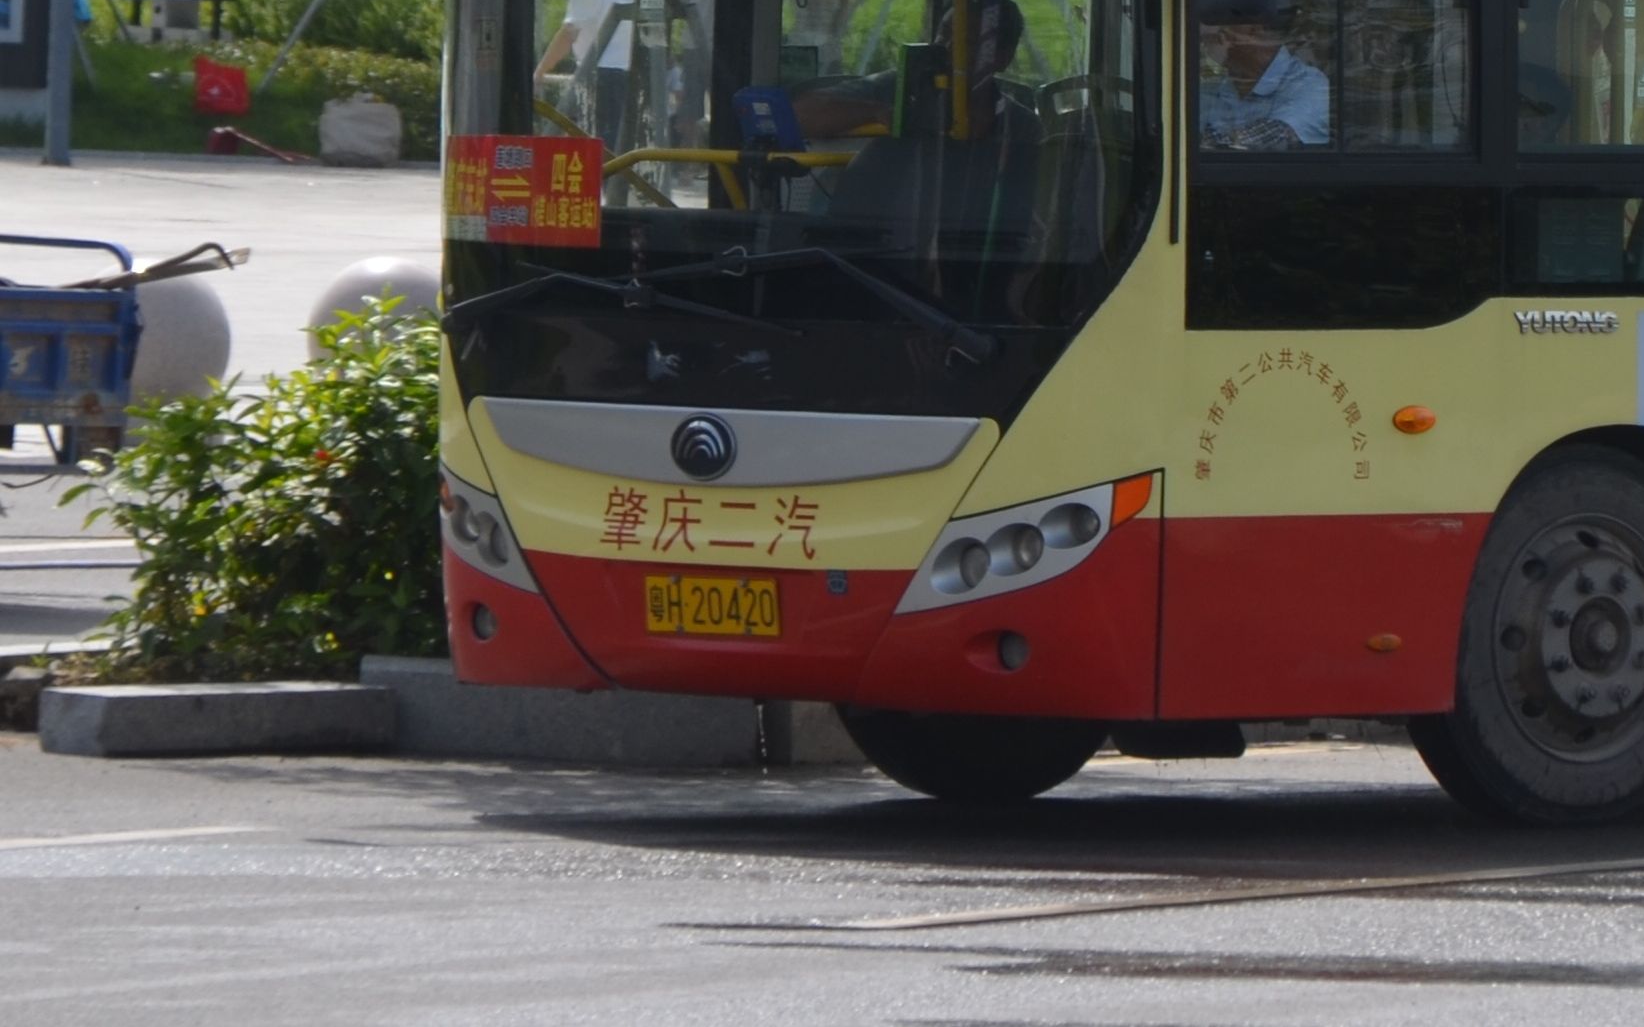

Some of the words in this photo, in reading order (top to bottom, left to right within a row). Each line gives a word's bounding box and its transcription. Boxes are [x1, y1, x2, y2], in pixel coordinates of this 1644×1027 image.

[1514, 310, 1620, 334] YUTONG
[1195, 347, 1370, 480] 肇庆市第二公共汽车有限公司
[601, 485, 820, 561] 肇庆二汽
